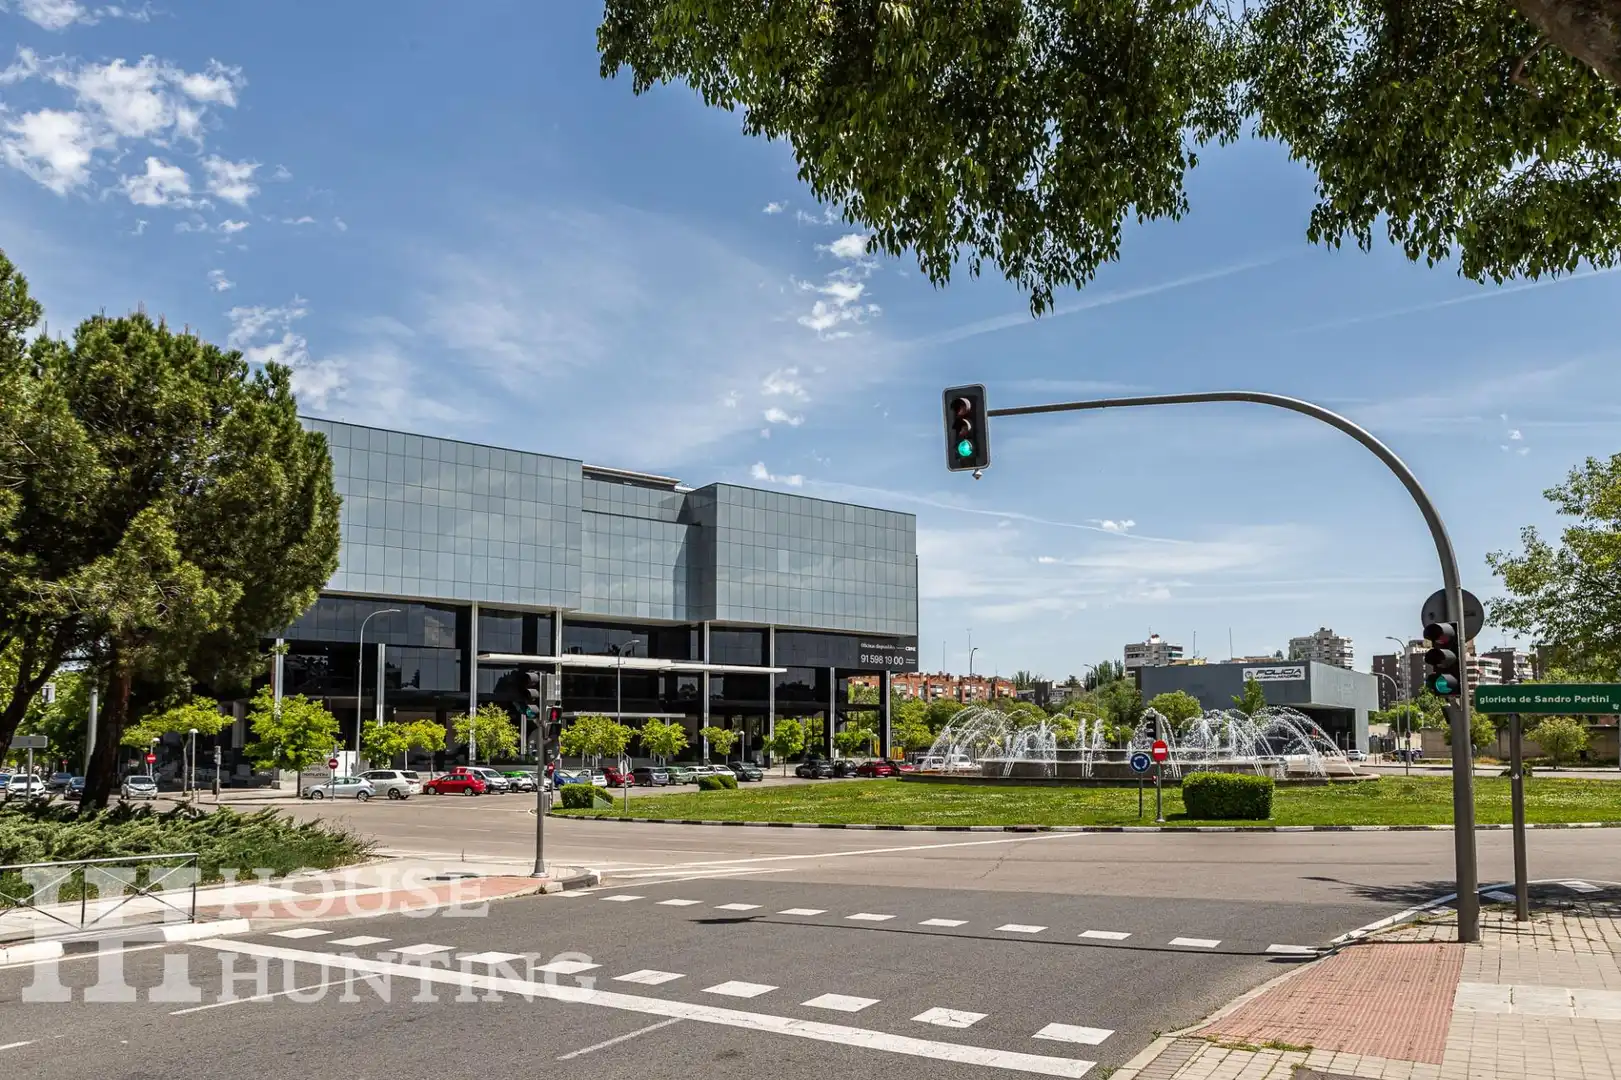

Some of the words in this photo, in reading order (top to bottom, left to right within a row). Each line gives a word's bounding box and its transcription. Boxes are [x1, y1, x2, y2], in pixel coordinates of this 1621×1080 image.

[860, 654, 869, 663] 91
[870, 655, 884, 664] 598
[885, 656, 893, 665] 19
[893, 656, 904, 665] 00
[1479, 695, 1516, 705] glorieta
[1519, 695, 1532, 703] de
[1534, 695, 1572, 703] Sandro
[1574, 695, 1610, 703] Pertini
